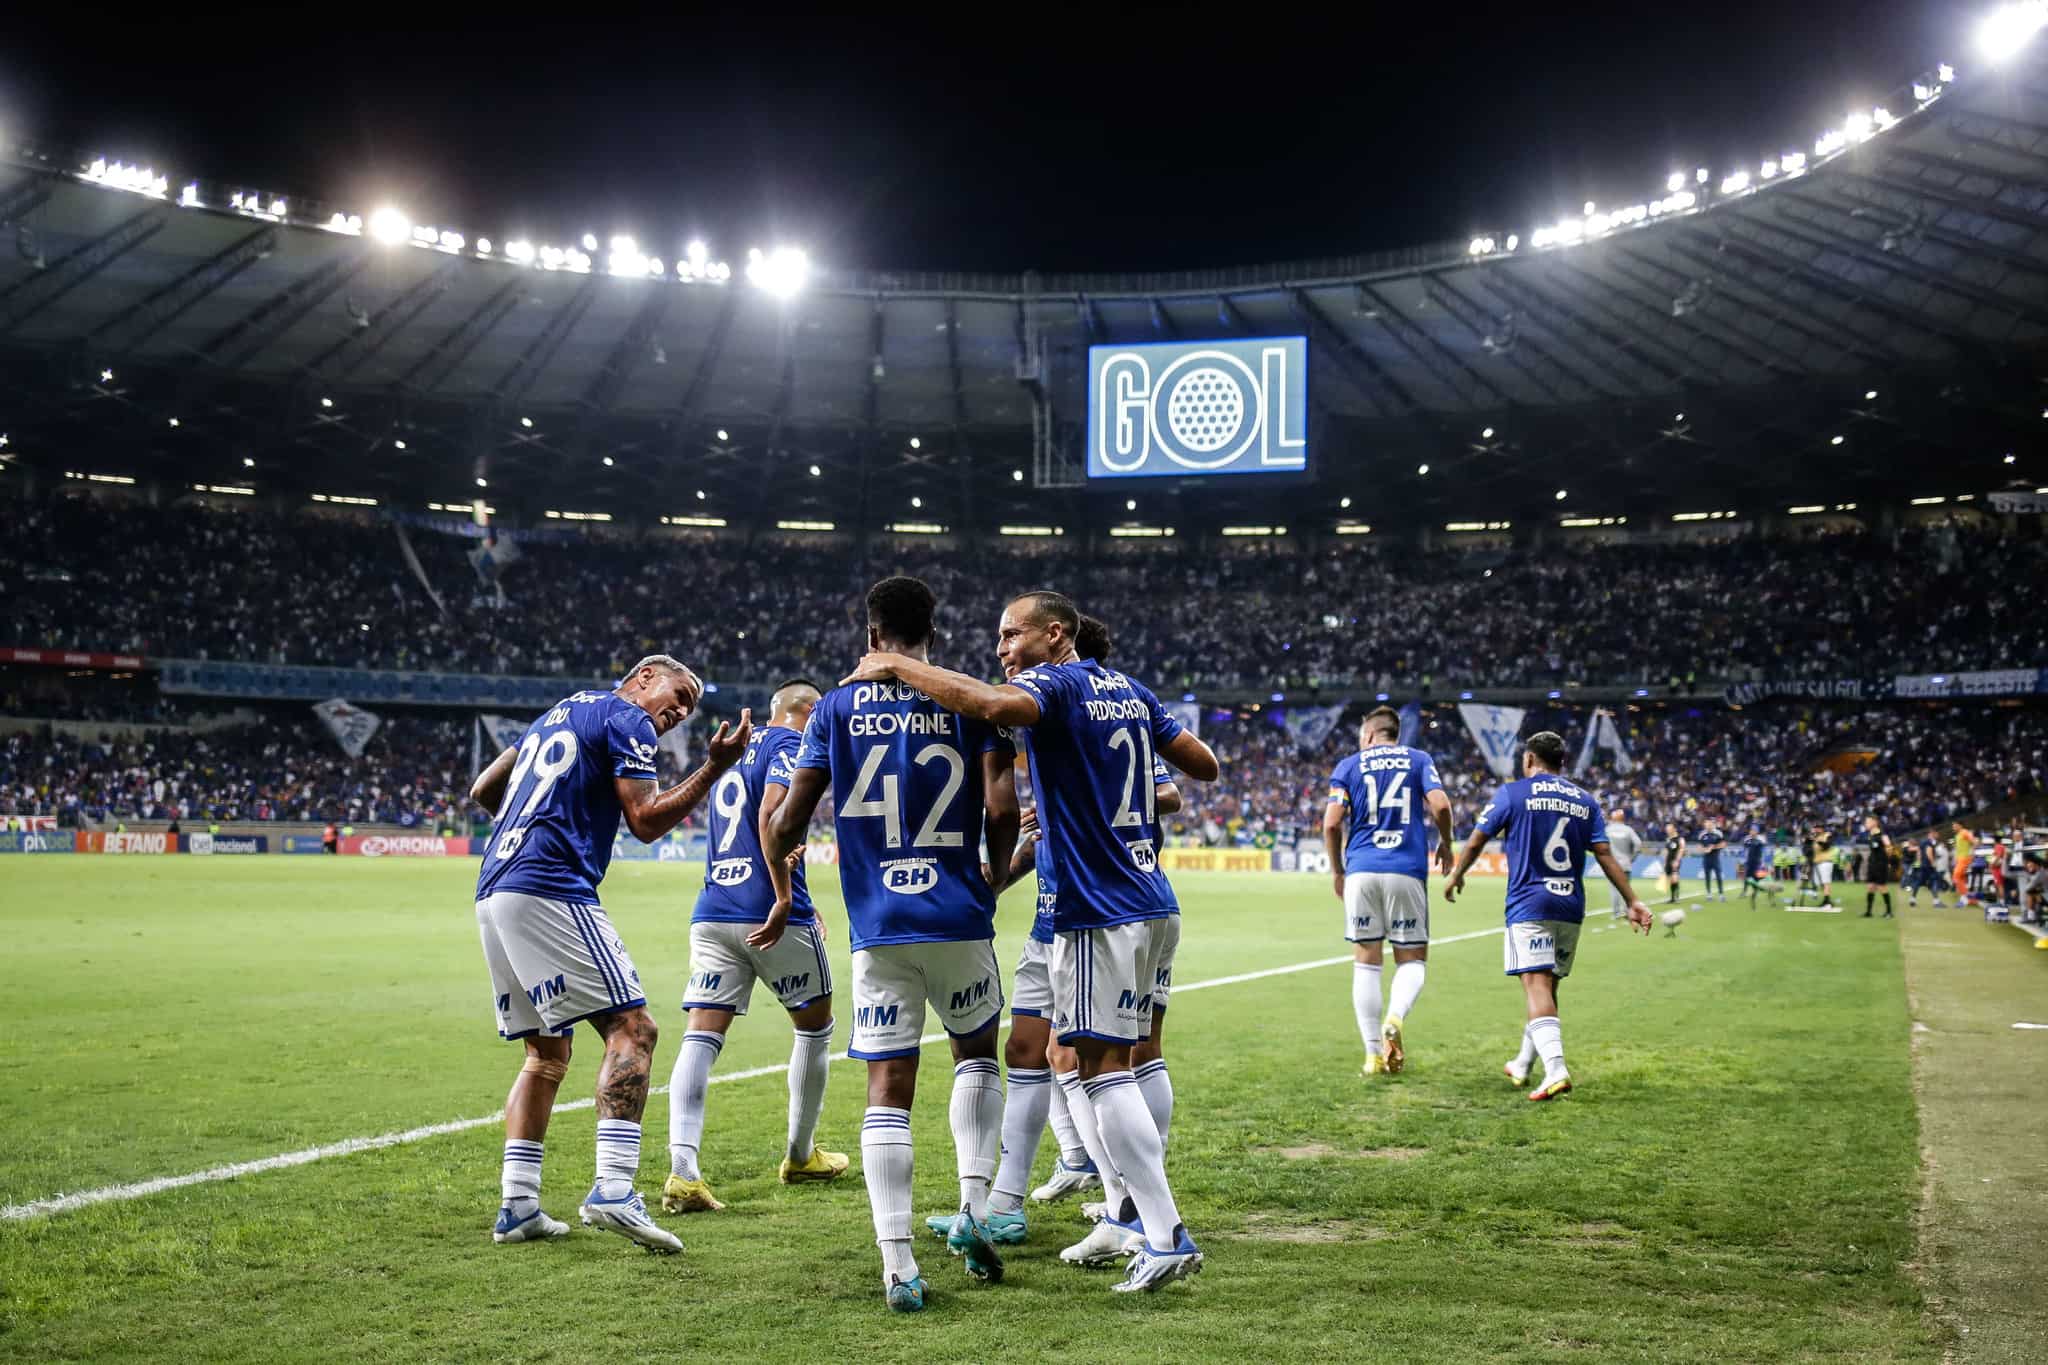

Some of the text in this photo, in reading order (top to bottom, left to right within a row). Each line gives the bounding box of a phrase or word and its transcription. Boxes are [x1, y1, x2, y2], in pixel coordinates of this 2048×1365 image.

[1100, 347, 1306, 472] GOL
[853, 681, 932, 710] pixb
[849, 712, 952, 737] GEOVANE
[494, 730, 578, 822] 99
[839, 743, 965, 849] 42
[1108, 727, 1154, 827] 21
[1531, 780, 1582, 799] pixbet
[715, 771, 747, 853] 9
[1363, 772, 1411, 825] 14
[1525, 798, 1569, 813] MATHEUS
[103, 832, 166, 853] BETANO
[388, 836, 447, 855] KRONA
[1543, 817, 1573, 872] 6
[890, 867, 930, 887] BH
